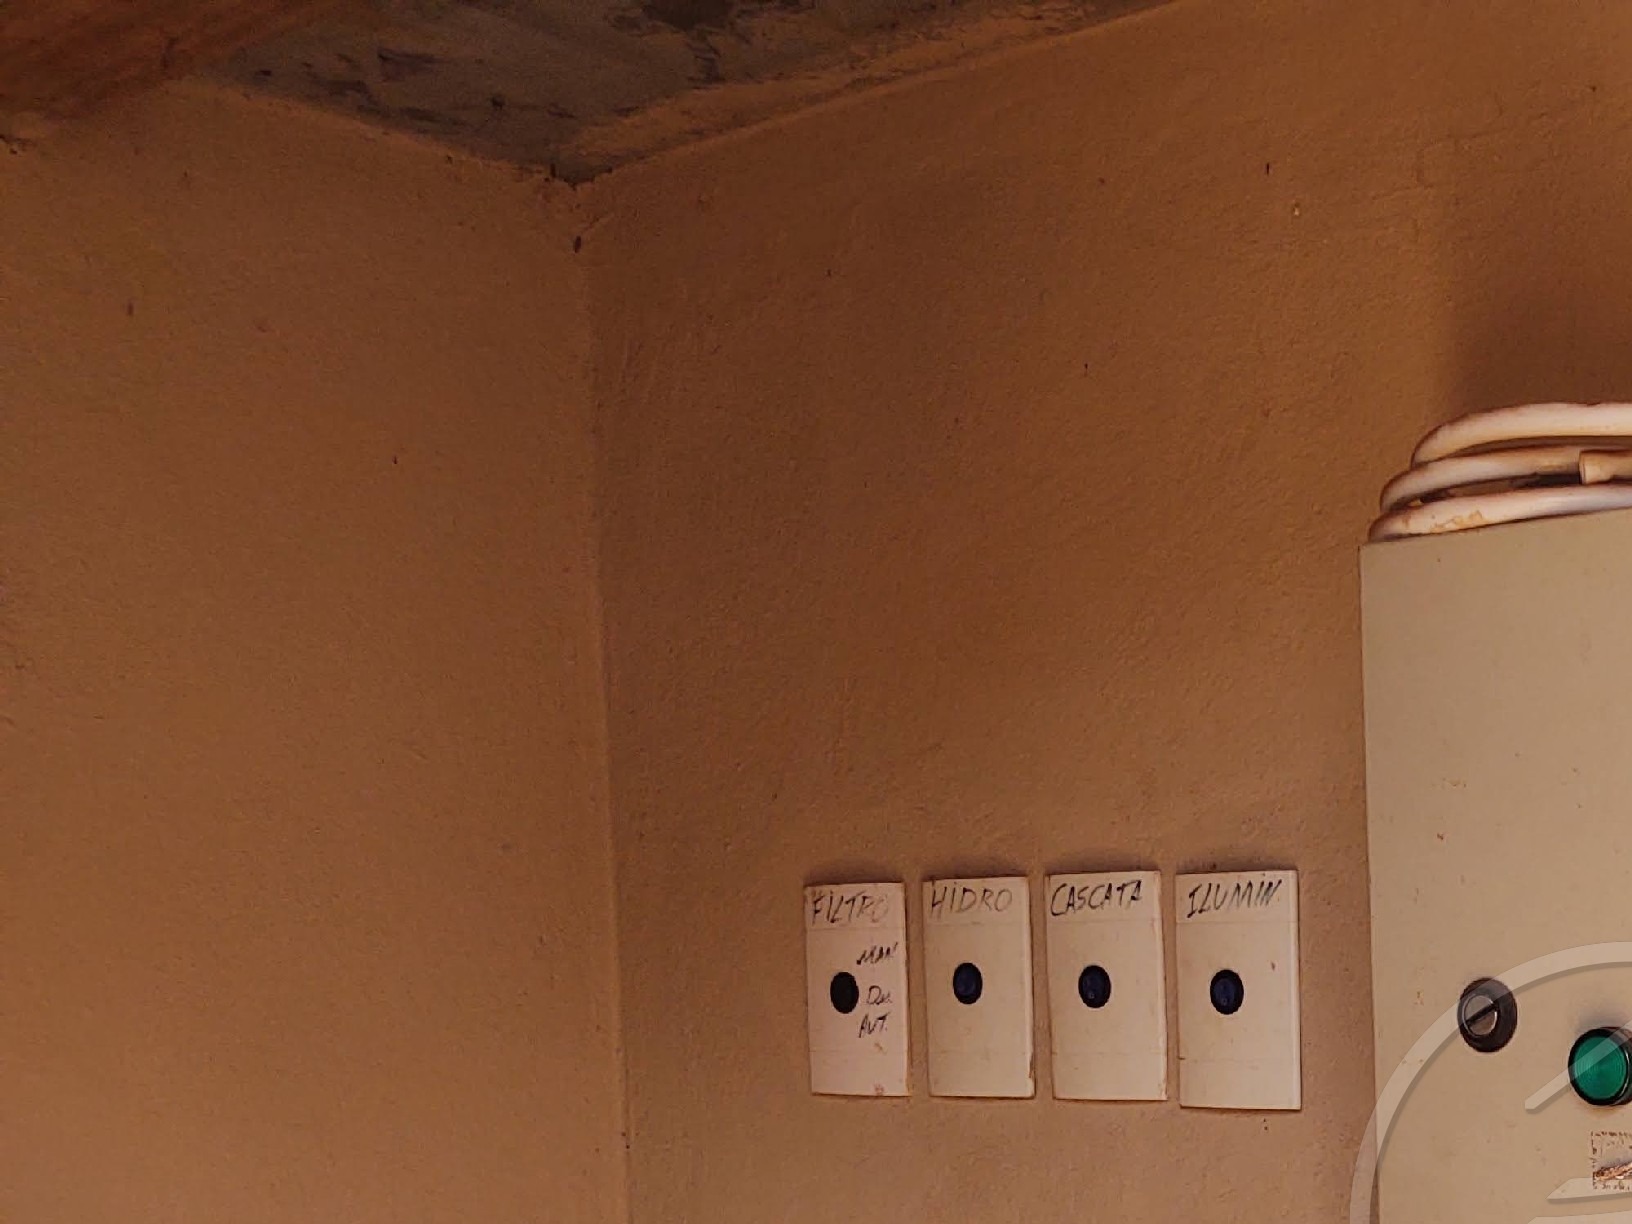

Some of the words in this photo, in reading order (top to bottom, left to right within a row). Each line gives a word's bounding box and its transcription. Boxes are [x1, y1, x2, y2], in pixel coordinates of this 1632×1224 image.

[811, 889, 889, 924] FILTRO
[929, 882, 1013, 918] HIDRO
[1050, 879, 1143, 916] CASCATA
[1187, 874, 1283, 918] ILUMIN
